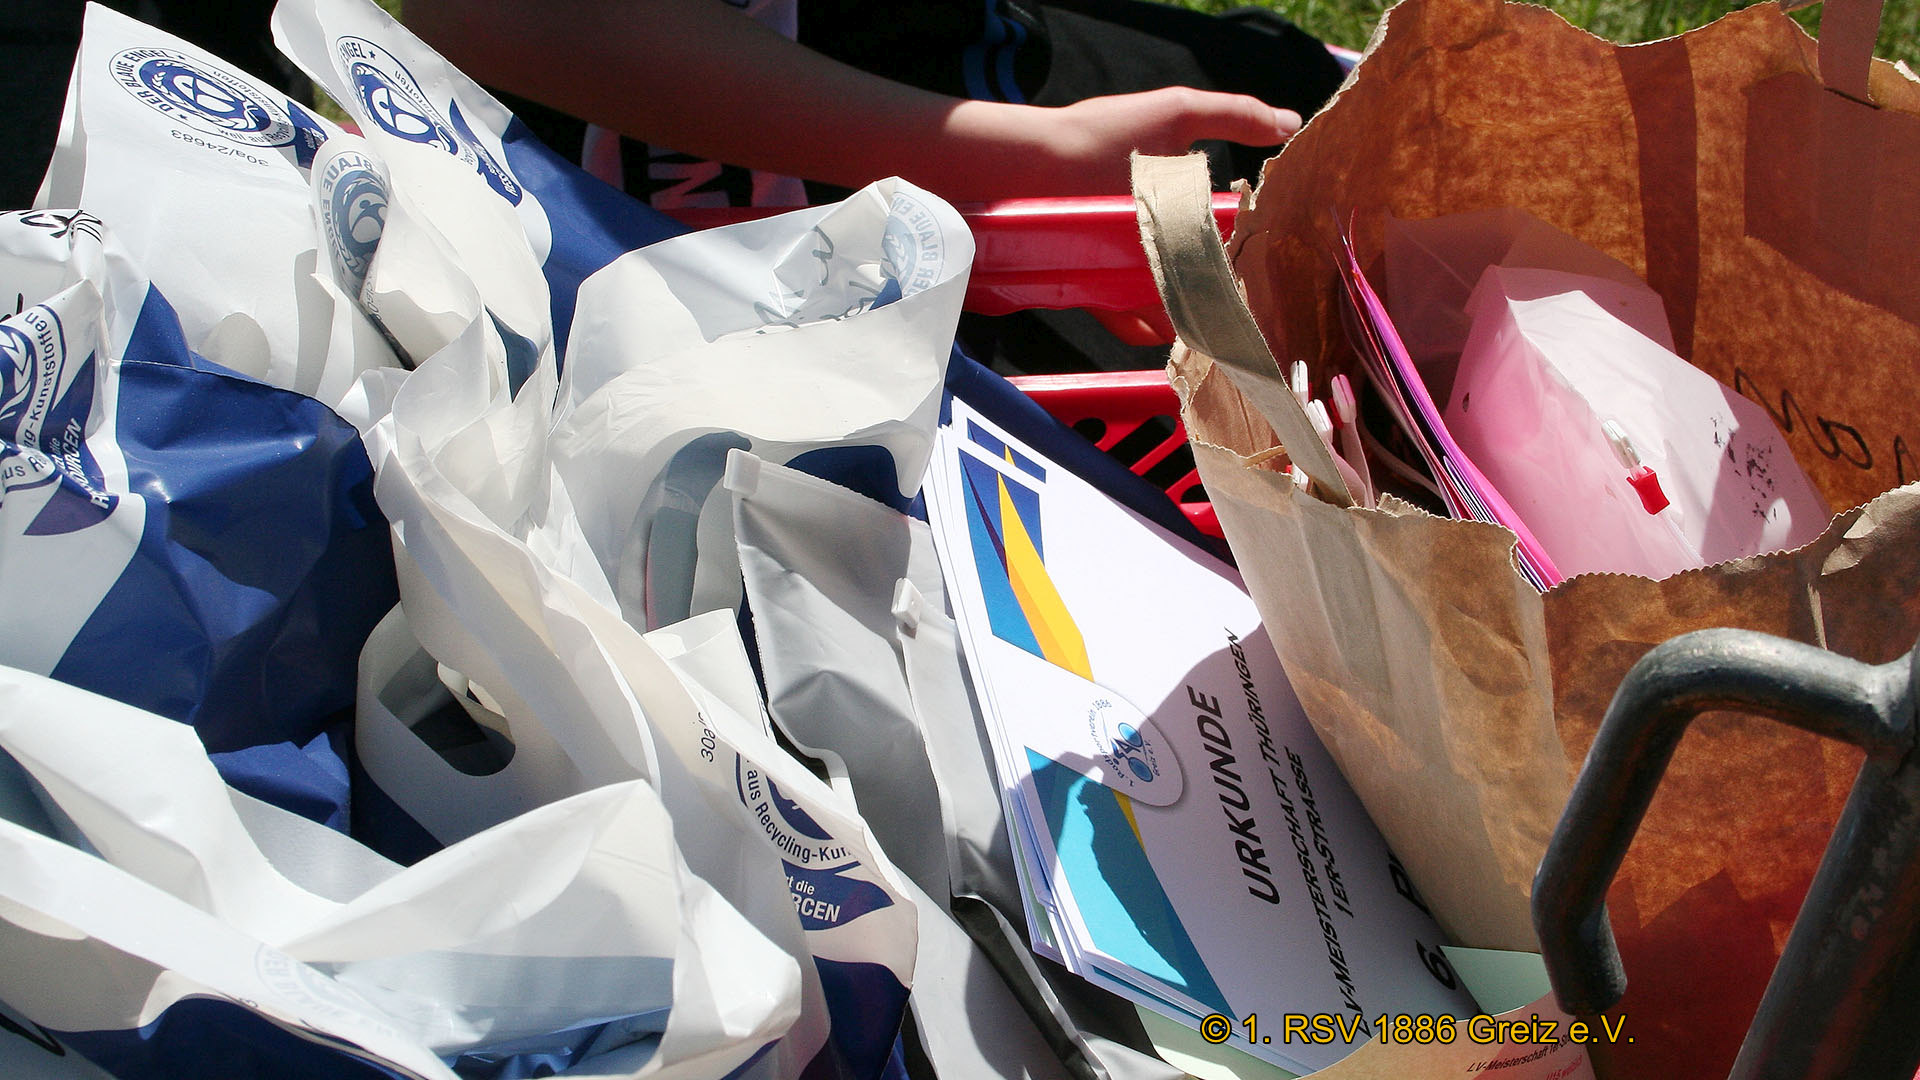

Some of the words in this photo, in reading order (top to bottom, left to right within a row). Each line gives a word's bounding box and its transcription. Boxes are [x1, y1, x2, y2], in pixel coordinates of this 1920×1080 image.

[123, 50, 174, 63] ENGEL
[116, 61, 142, 88] BLAUE
[137, 90, 174, 112] DER
[171, 129, 269, 167] 30a/24683
[2, 465, 26, 480] us
[1224, 626, 1280, 766] THÜRINGEN
[747, 769, 761, 800] aus
[1186, 685, 1280, 905] URKUNDE
[1284, 745, 1354, 918] 1ER-STRASSE
[796, 880, 815, 895] die
[1466, 1045, 1549, 1073] LV-Meisterschaft
